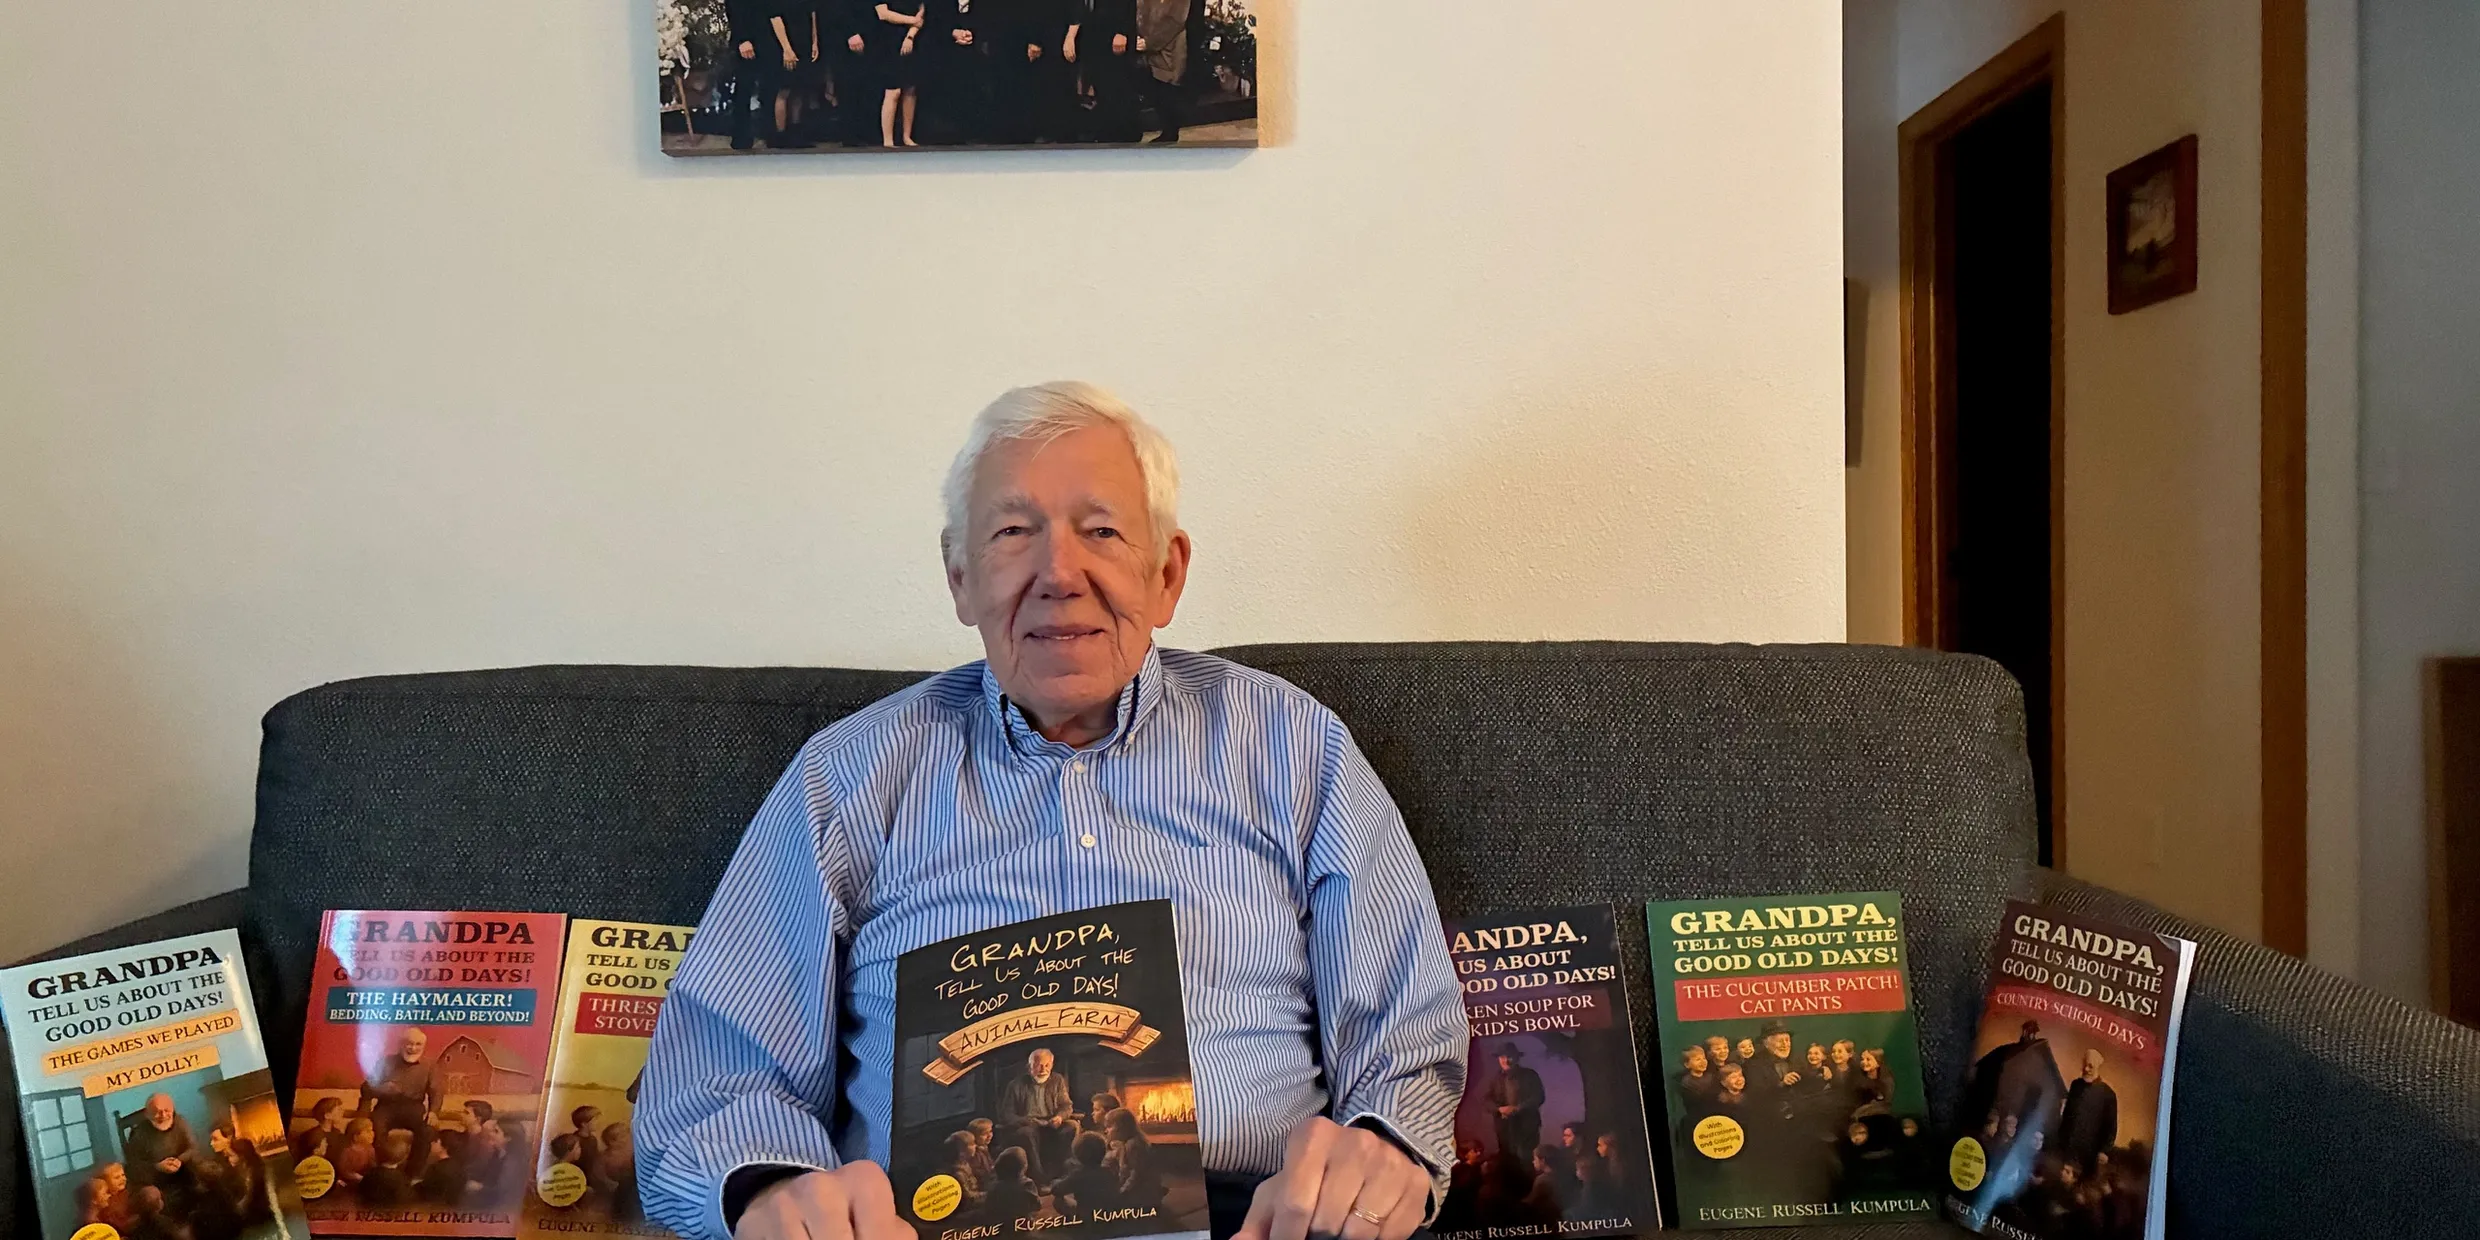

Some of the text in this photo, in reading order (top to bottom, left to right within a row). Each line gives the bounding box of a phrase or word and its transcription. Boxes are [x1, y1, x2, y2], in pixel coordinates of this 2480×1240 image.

[1671, 902, 1896, 935] GRANDPA,
[345, 920, 534, 944] RANDPA
[1673, 929, 1898, 953] TELL US ABOUT THE
[950, 923, 1120, 973] GRANDPA,
[2014, 914, 2165, 975] GRANDPA,
[420, 951, 488, 963] ABOUT
[493, 951, 535, 963] THE
[587, 954, 638, 968] TELL
[644, 957, 671, 970] US
[1457, 950, 1572, 974] US ABOUT
[1674, 947, 1898, 973] GOOD OLD DAYS!
[2011, 939, 2163, 994] TELL US ABOUT THE
[406, 967, 453, 982] OLD
[460, 968, 531, 983] DAYS!
[585, 972, 657, 990] GOOD
[934, 946, 1137, 1001] TELL US ABOUT THE
[1503, 974, 1548, 990] OLD
[1555, 966, 1616, 985] DAYS!
[28, 971, 225, 1023] TELL US ABOUT THE
[347, 991, 513, 1007] THE HAYMAKER!
[962, 973, 1120, 1020] GOOD OLD DAYS!
[1683, 975, 1899, 999] THE CUCUMBER PATCH!
[2001, 957, 2160, 1018] GOOD OLD DAYS!
[45, 991, 224, 1042] GOOD OLD DAYS!
[329, 1009, 530, 1023] BEDDING, BATH, AND BEYOND!
[1504, 998, 1553, 1015] SOUP
[1558, 994, 1595, 1010] FOR
[1740, 996, 1843, 1015] CAT PANTS
[960, 1007, 1121, 1052] ANIMAL FARM
[1471, 1014, 1581, 1037] KID'S BOWL
[1996, 992, 2147, 1050] COUNTRY SCHOOL DAYS
[49, 1016, 234, 1069] THE GAMES WE PLAYED
[106, 1070, 133, 1088] MY
[1699, 1198, 1931, 1221] EUGENE RUSSELL KUMPULA
[940, 1207, 1157, 1240] EUGENE RUSSELL KUMPULA
[1488, 1224, 1552, 1238] RUSSELL
[1558, 1217, 1632, 1233] KUMPULA
